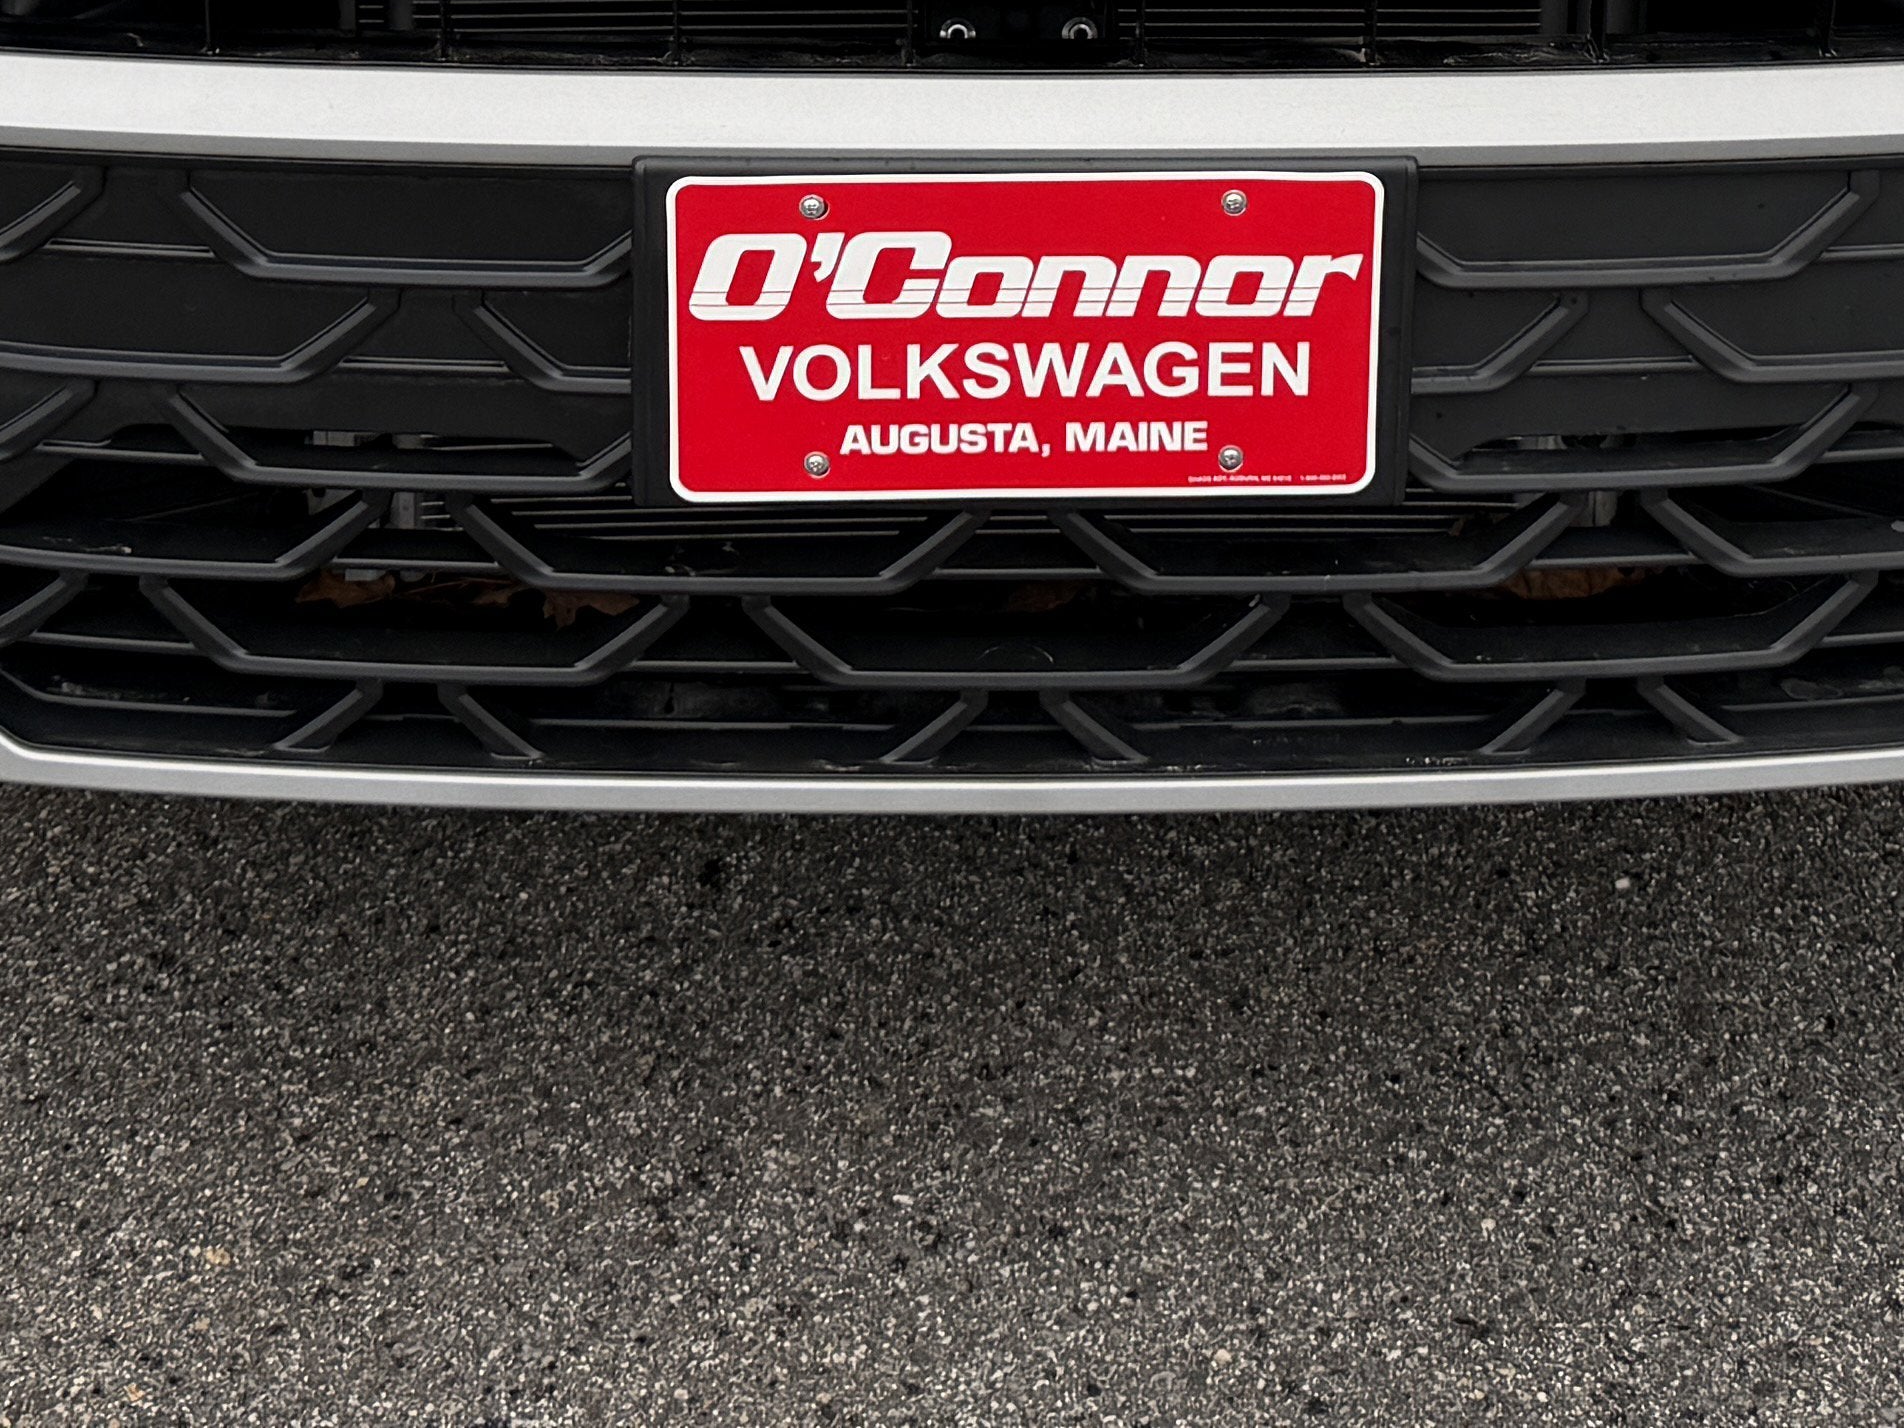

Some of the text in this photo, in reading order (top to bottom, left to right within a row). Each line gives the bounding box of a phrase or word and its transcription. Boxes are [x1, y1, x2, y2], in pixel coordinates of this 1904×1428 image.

[688, 231, 1363, 322] O'Connor
[739, 341, 1311, 401] VOLKSWAGEN
[839, 420, 1208, 459] AUGUSTA, MAINE
